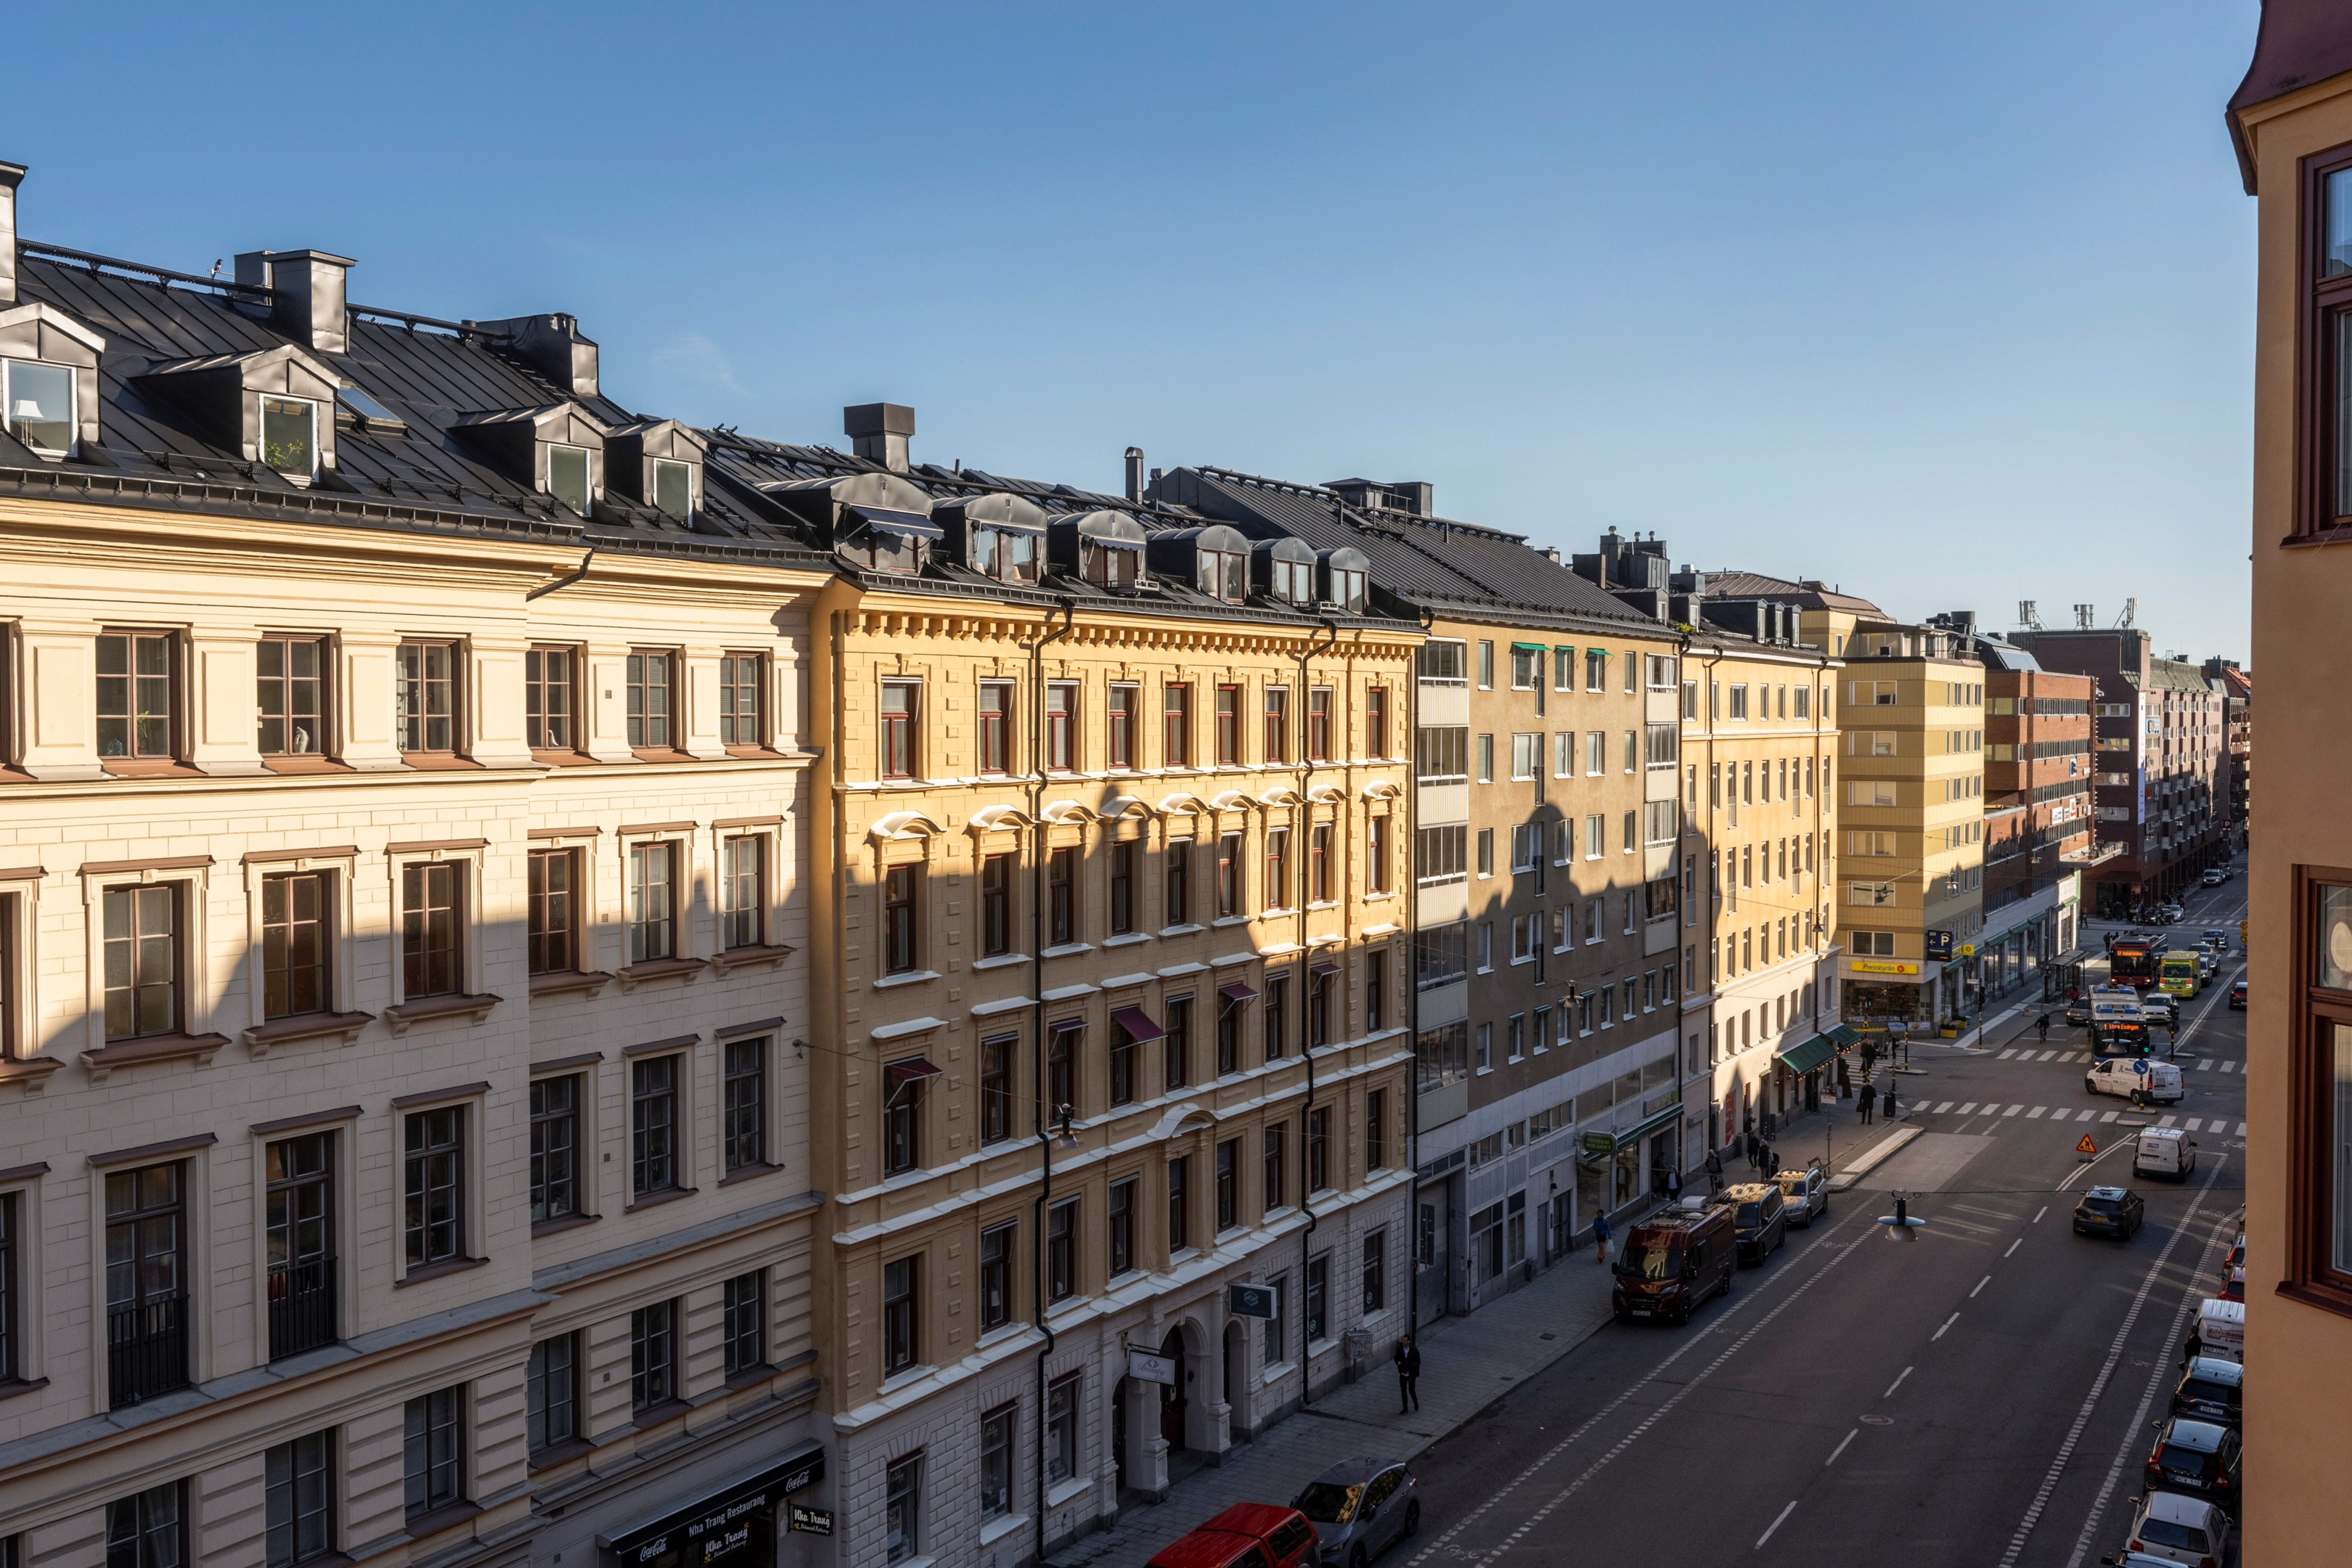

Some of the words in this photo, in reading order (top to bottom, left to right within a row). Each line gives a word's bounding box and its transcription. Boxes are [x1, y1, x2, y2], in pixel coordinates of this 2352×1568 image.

[1941, 936, 1949, 946] P
[1863, 963, 1895, 972] Pressbyrån
[1138, 1363, 1165, 1377] Beauty
[688, 1523, 704, 1538] Nha
[705, 1512, 727, 1533] Trang
[727, 1494, 765, 1518] Restaurang
[794, 1508, 809, 1522] Nha
[809, 1511, 830, 1529] Trang
[705, 1540, 723, 1555] Nha
[724, 1528, 748, 1545] Trang
